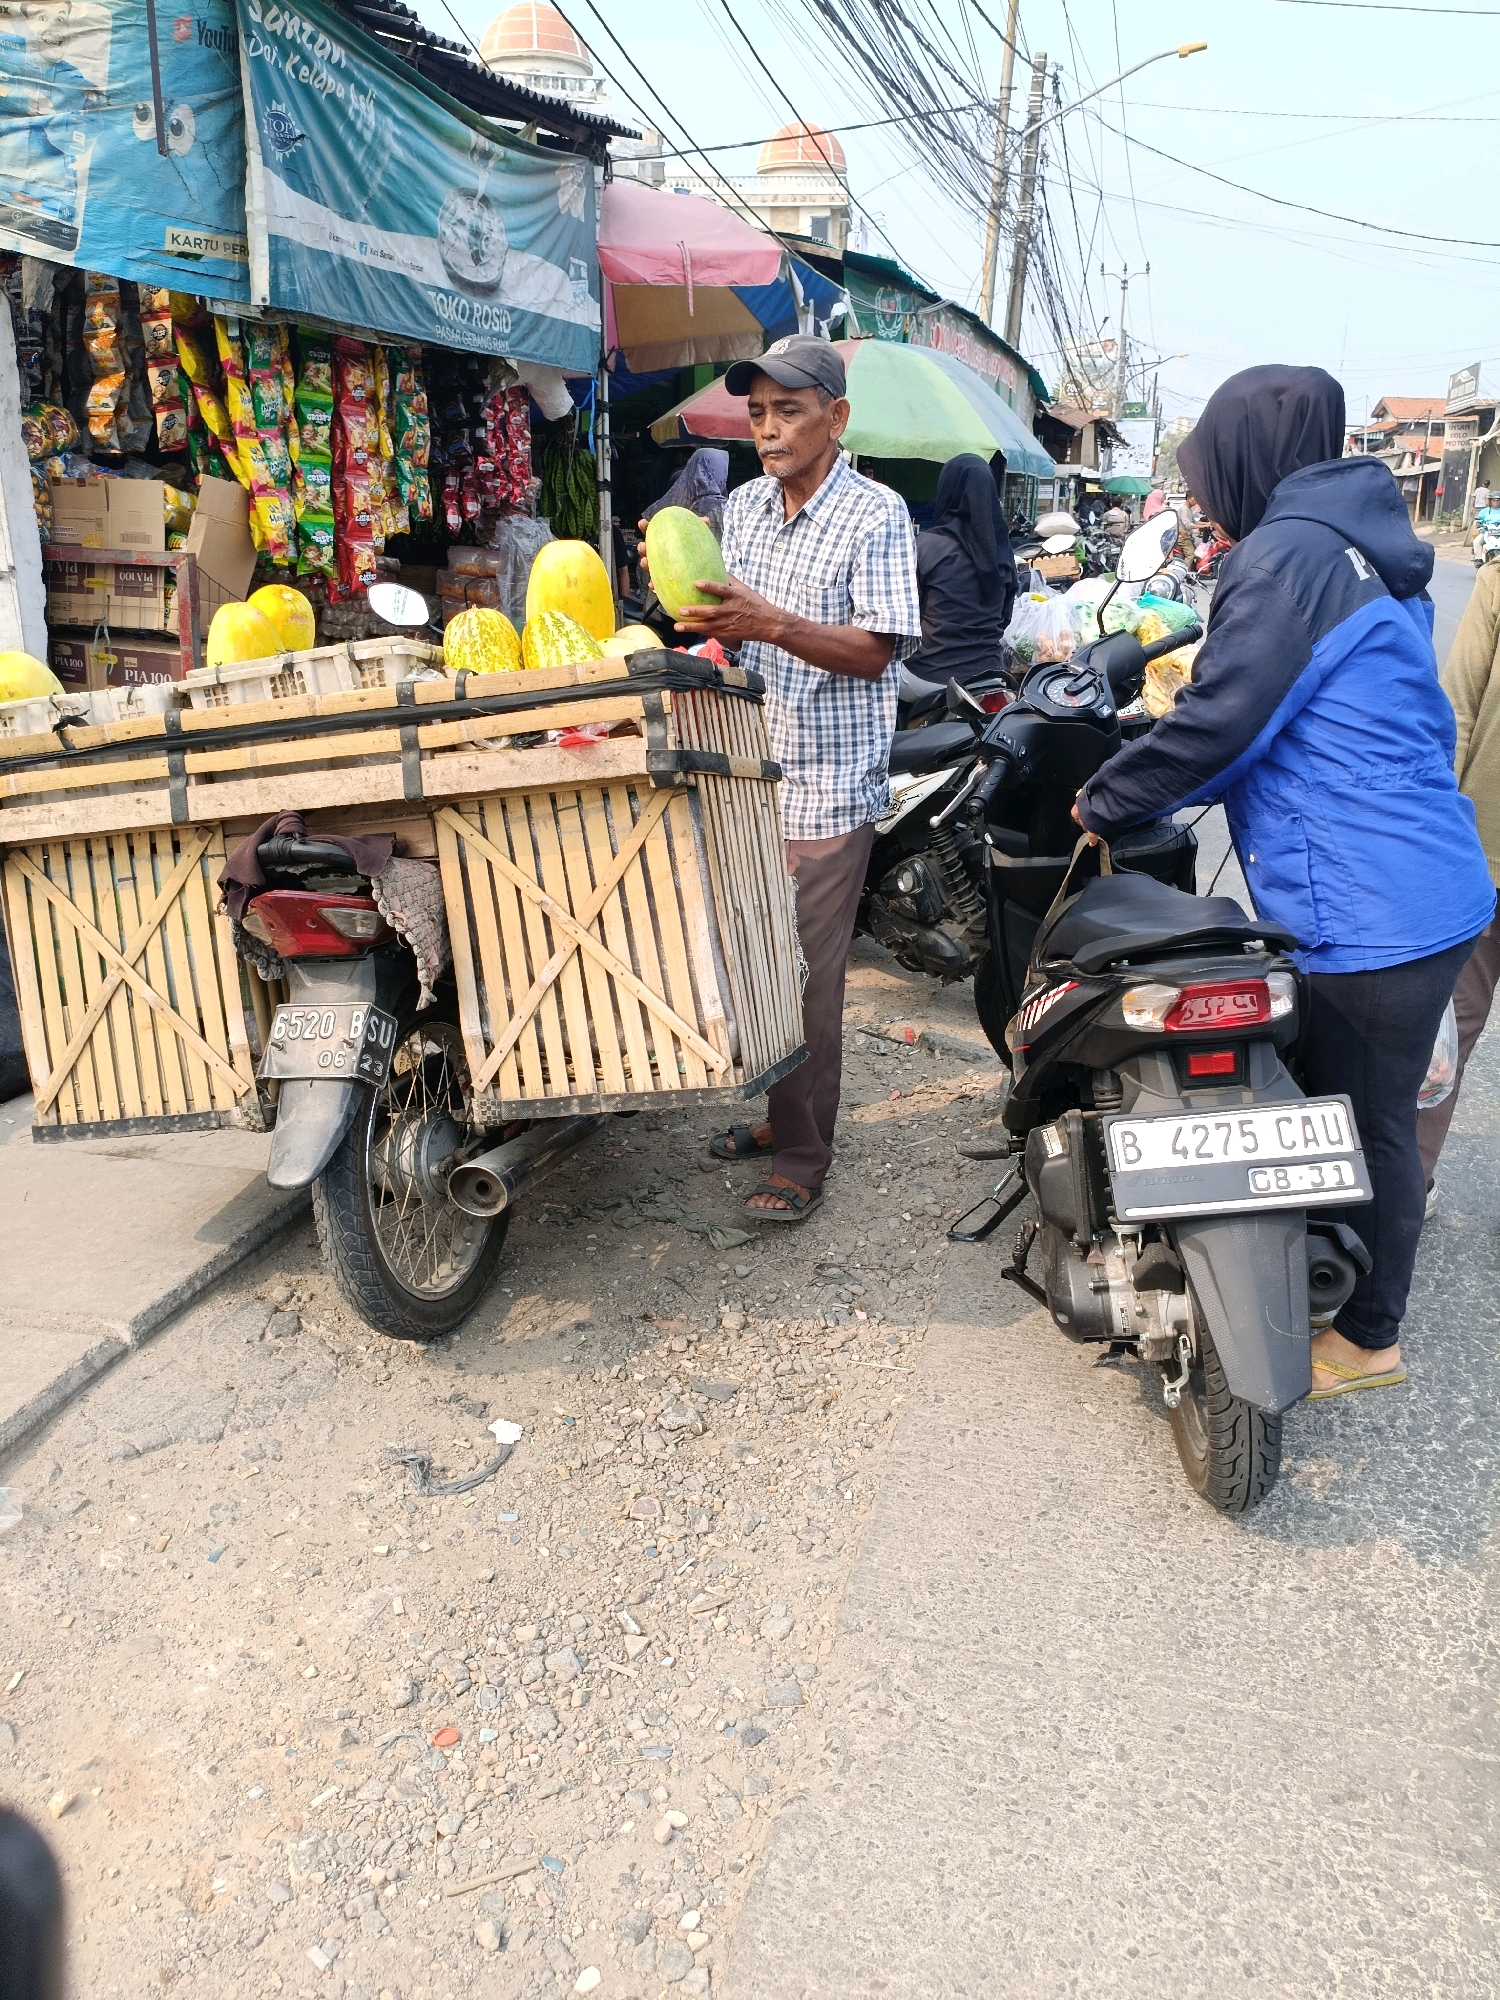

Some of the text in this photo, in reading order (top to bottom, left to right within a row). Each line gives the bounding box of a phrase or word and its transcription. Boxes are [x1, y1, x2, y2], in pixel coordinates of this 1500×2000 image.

[197, 19, 239, 53] YouTu
[285, 52, 345, 100] Kelapa
[269, 118, 293, 134] TOP
[171, 233, 249, 259] KARTU PER
[427, 291, 511, 334] TOKO ROSID
[435, 325, 462, 343] PASAR
[461, 331, 494, 351] GEBANG
[120, 571, 153, 583] PIA 100
[54, 656, 69, 667] PIA
[69, 658, 84, 669] 100
[124, 669, 173, 684] PIA 100
[273, 1010, 393, 1049] 6520 BSU
[1120, 1112, 1344, 1165] B 4275 CAU
[1142, 1173, 1205, 1187] HONDA
